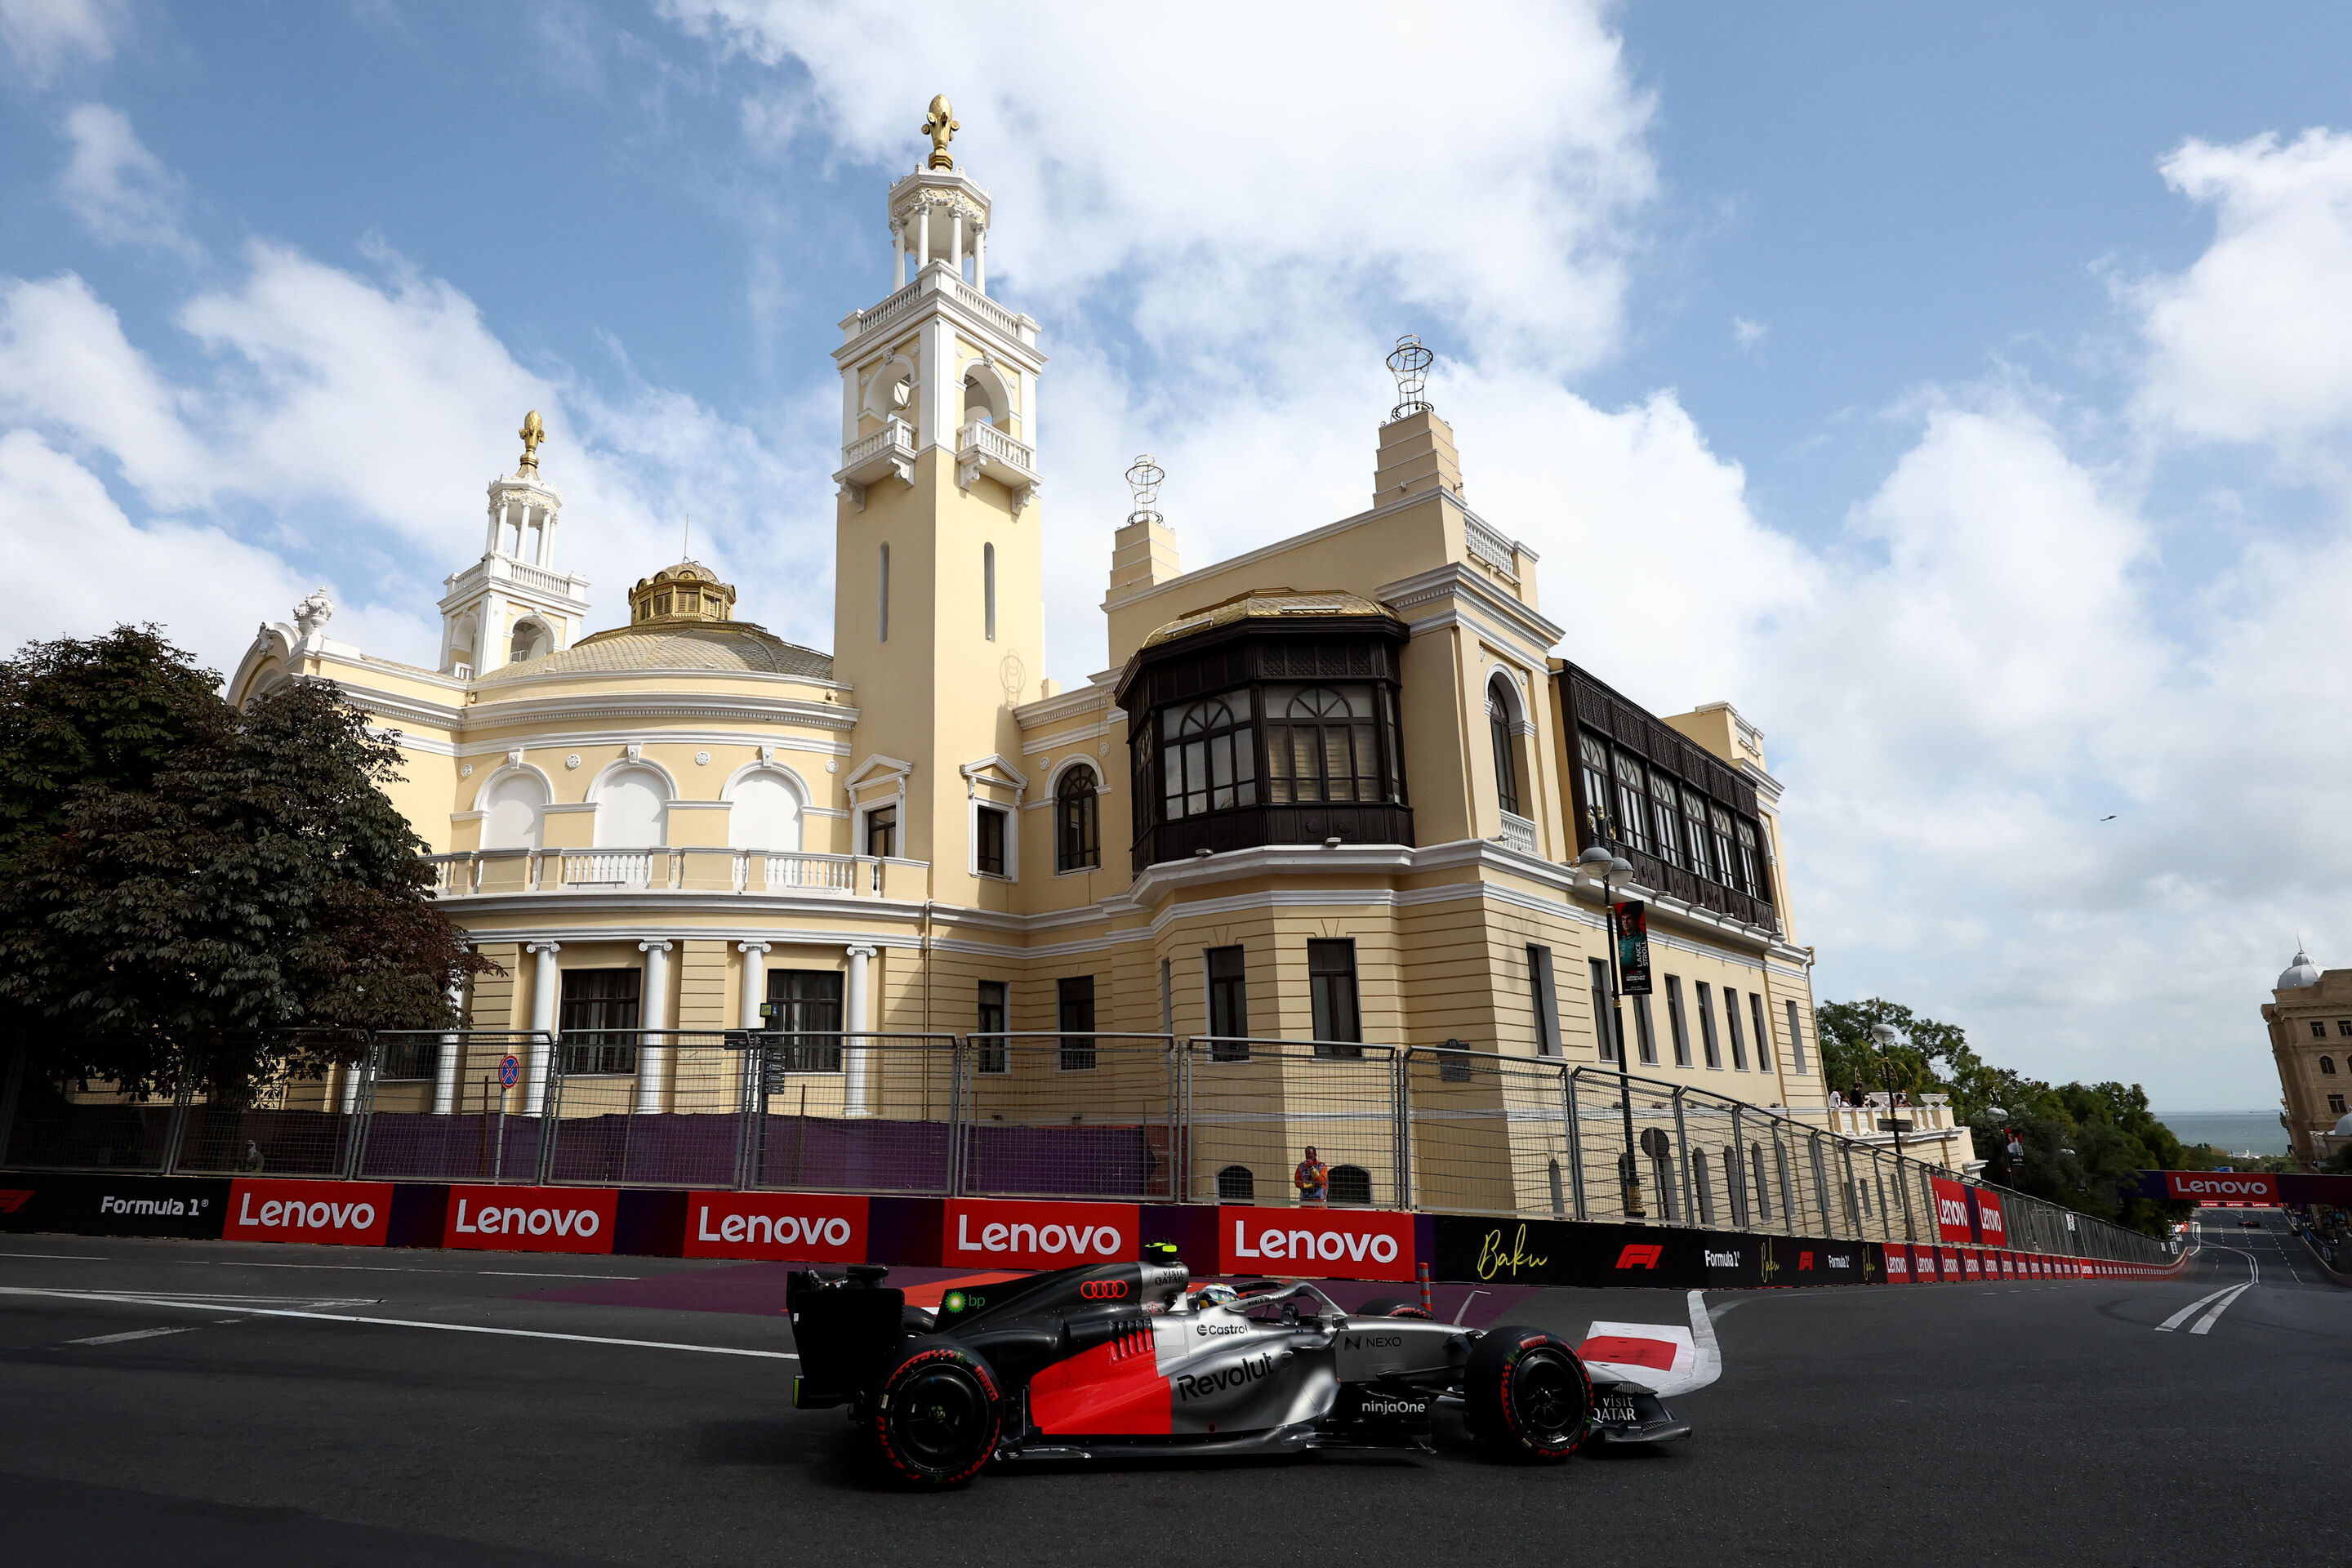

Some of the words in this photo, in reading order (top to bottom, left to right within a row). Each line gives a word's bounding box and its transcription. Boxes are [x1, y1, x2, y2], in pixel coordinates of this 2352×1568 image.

[2176, 1177, 2268, 1195] Lenovo
[101, 1196, 185, 1215] Formula
[239, 1193, 375, 1229] Lenovo
[1936, 1190, 1967, 1227] Lenovo
[457, 1200, 599, 1237] Lenovo
[699, 1206, 851, 1246] Lenovo
[1978, 1200, 2002, 1232] Lenovo
[959, 1214, 1121, 1255] Lenovo
[1236, 1220, 1398, 1263] Lenovo
[1477, 1223, 1548, 1280] Baku
[1705, 1250, 1733, 1267] Formula
[1761, 1237, 1780, 1283] Baku
[1828, 1255, 1845, 1268] Formula
[1885, 1252, 1906, 1273] Lenovo
[1915, 1253, 1935, 1273] Lenovo
[1941, 1254, 1958, 1272] Lenovo
[1155, 1276, 1184, 1286] QATAR
[969, 1294, 985, 1309] bp
[1209, 1325, 1248, 1335] Castrol
[1366, 1337, 1401, 1348] NEXO
[1177, 1352, 1274, 1401] Revolut
[1362, 1401, 1425, 1414] ninjaOne
[1603, 1394, 1633, 1407] visit
